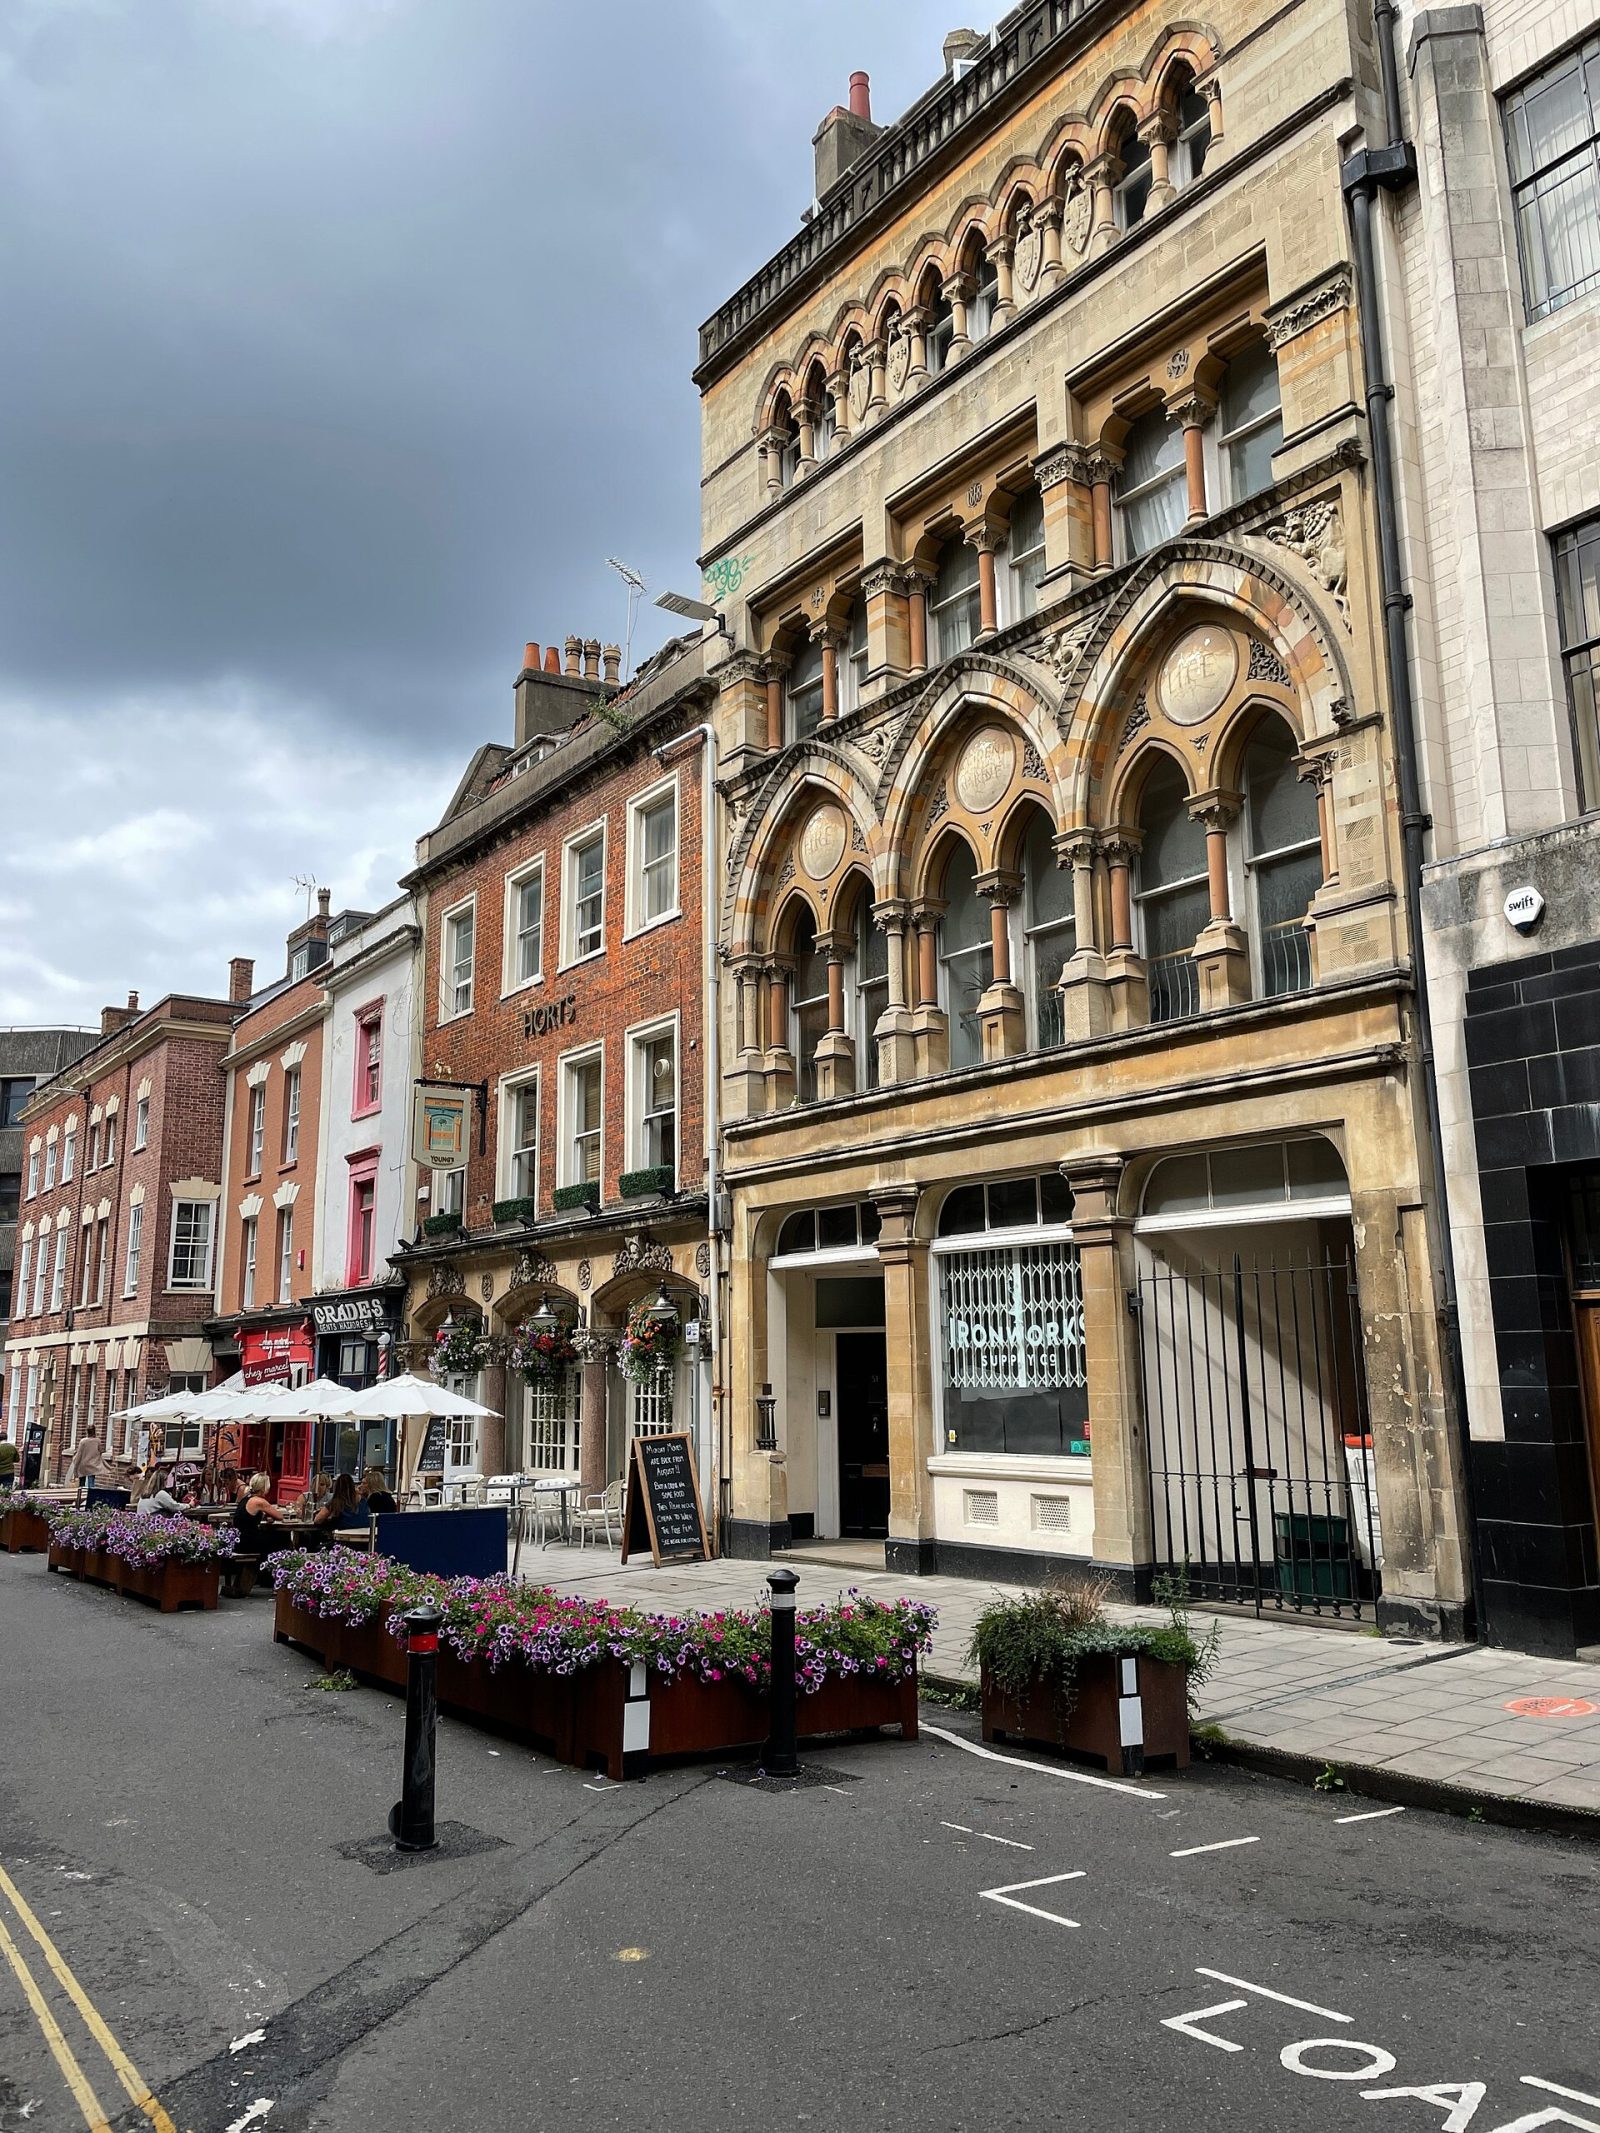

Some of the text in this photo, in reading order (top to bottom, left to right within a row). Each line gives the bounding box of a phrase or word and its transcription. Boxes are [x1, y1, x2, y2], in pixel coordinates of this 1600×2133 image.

[1508, 895, 1534, 911] swift
[524, 995, 576, 1040] HORTS
[314, 1299, 384, 1324] GRADES
[245, 1366, 263, 1381] chez
[264, 1358, 289, 1374] marcel
[982, 1353, 1035, 1367] SUPPY
[1160, 2000, 1600, 2133] LOA
